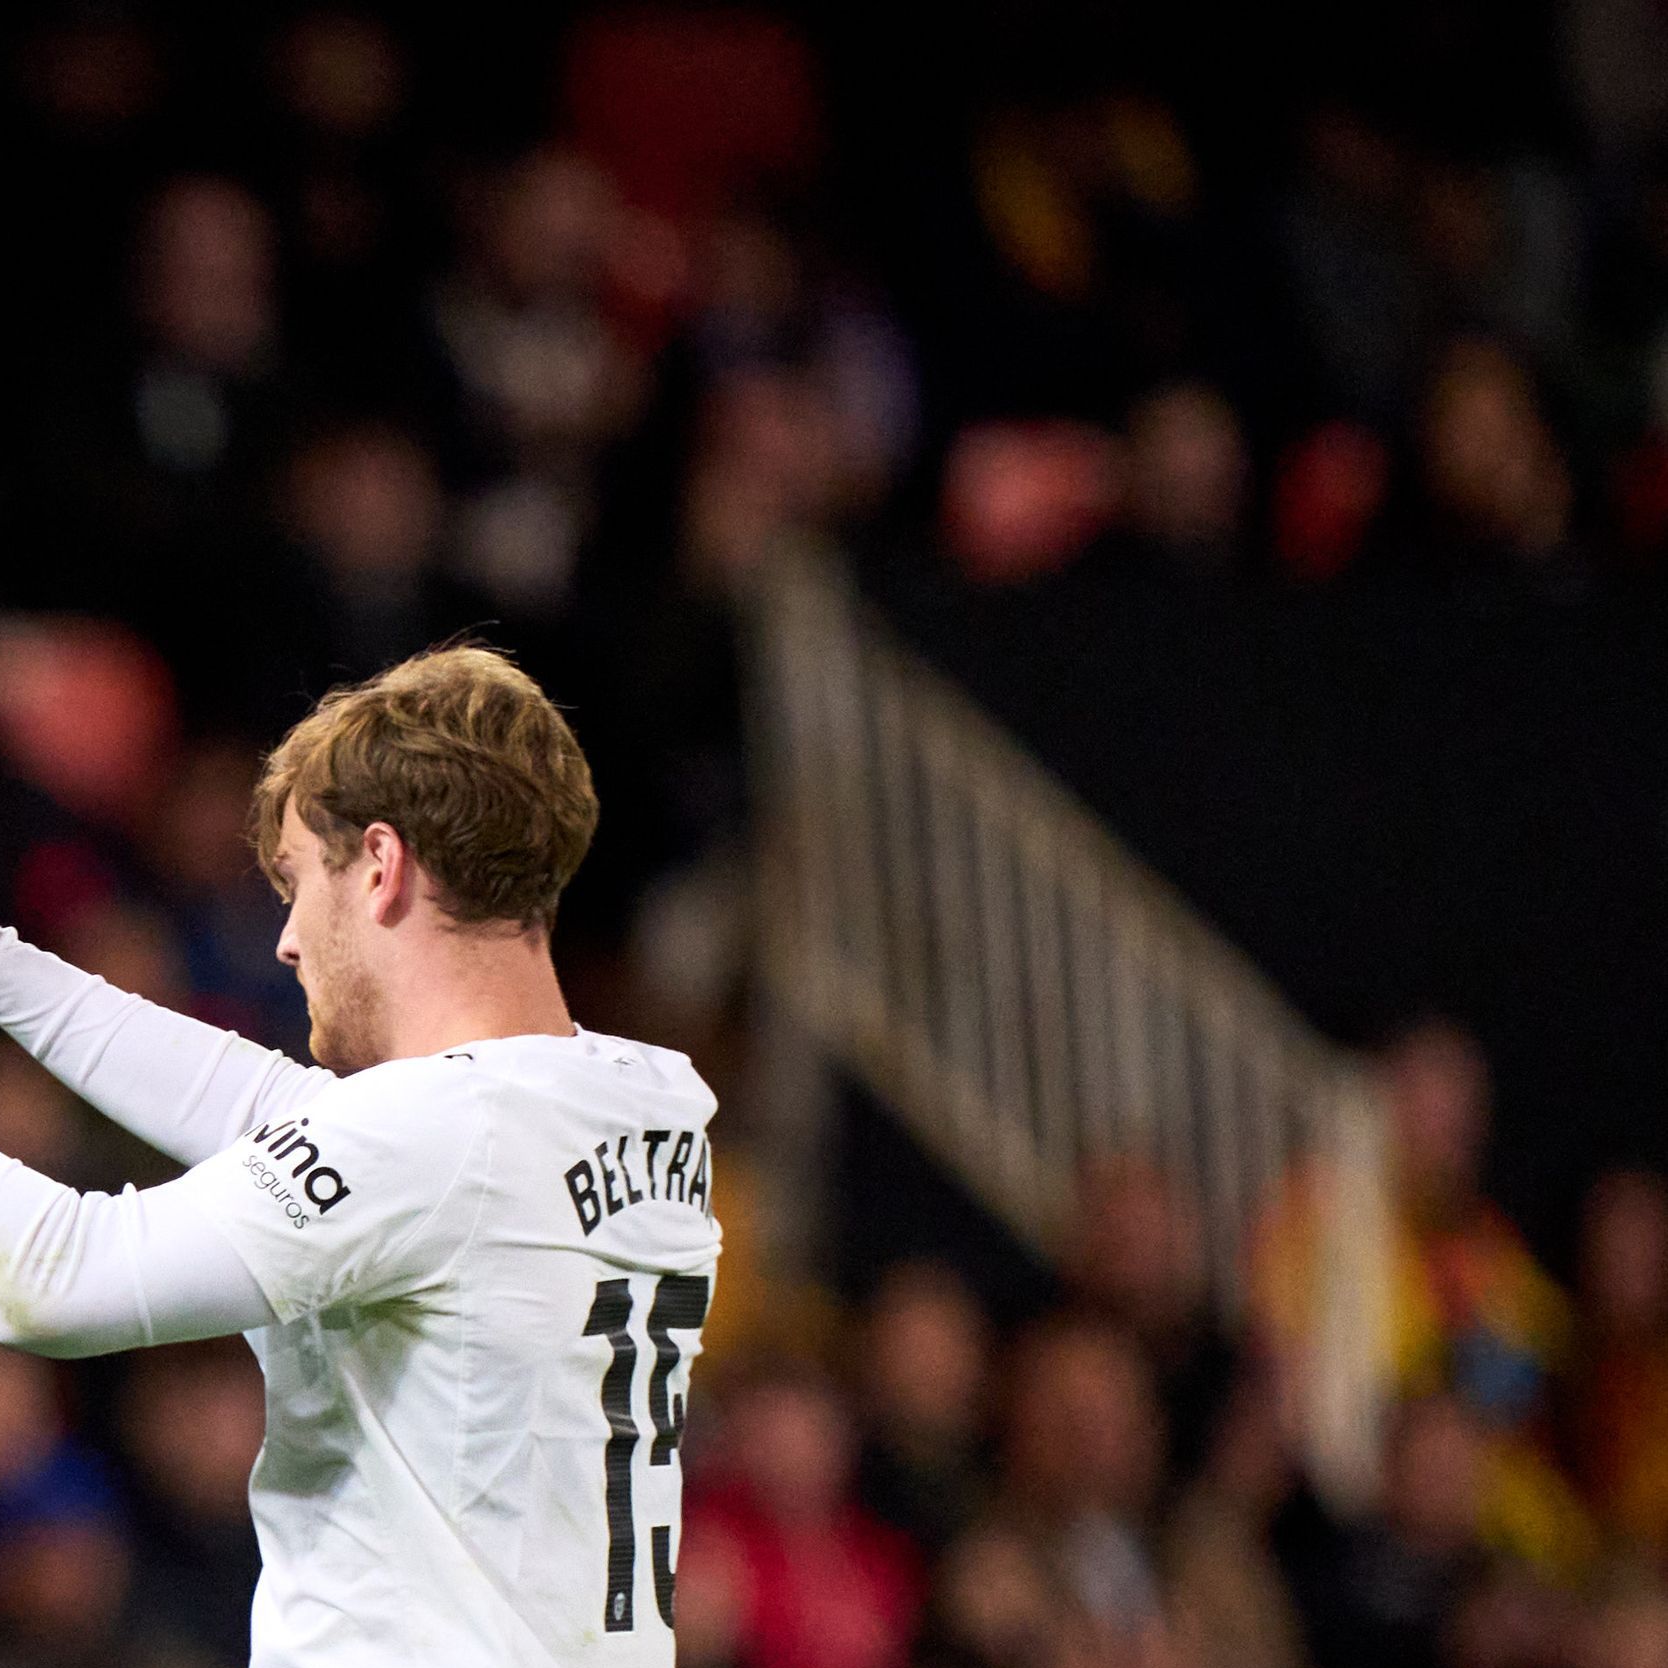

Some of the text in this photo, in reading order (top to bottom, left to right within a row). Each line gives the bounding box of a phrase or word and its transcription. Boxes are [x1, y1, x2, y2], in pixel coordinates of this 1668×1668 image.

[242, 1154, 311, 1230] seguros
[244, 1117, 352, 1216] vina
[563, 1129, 714, 1237] BELTRA
